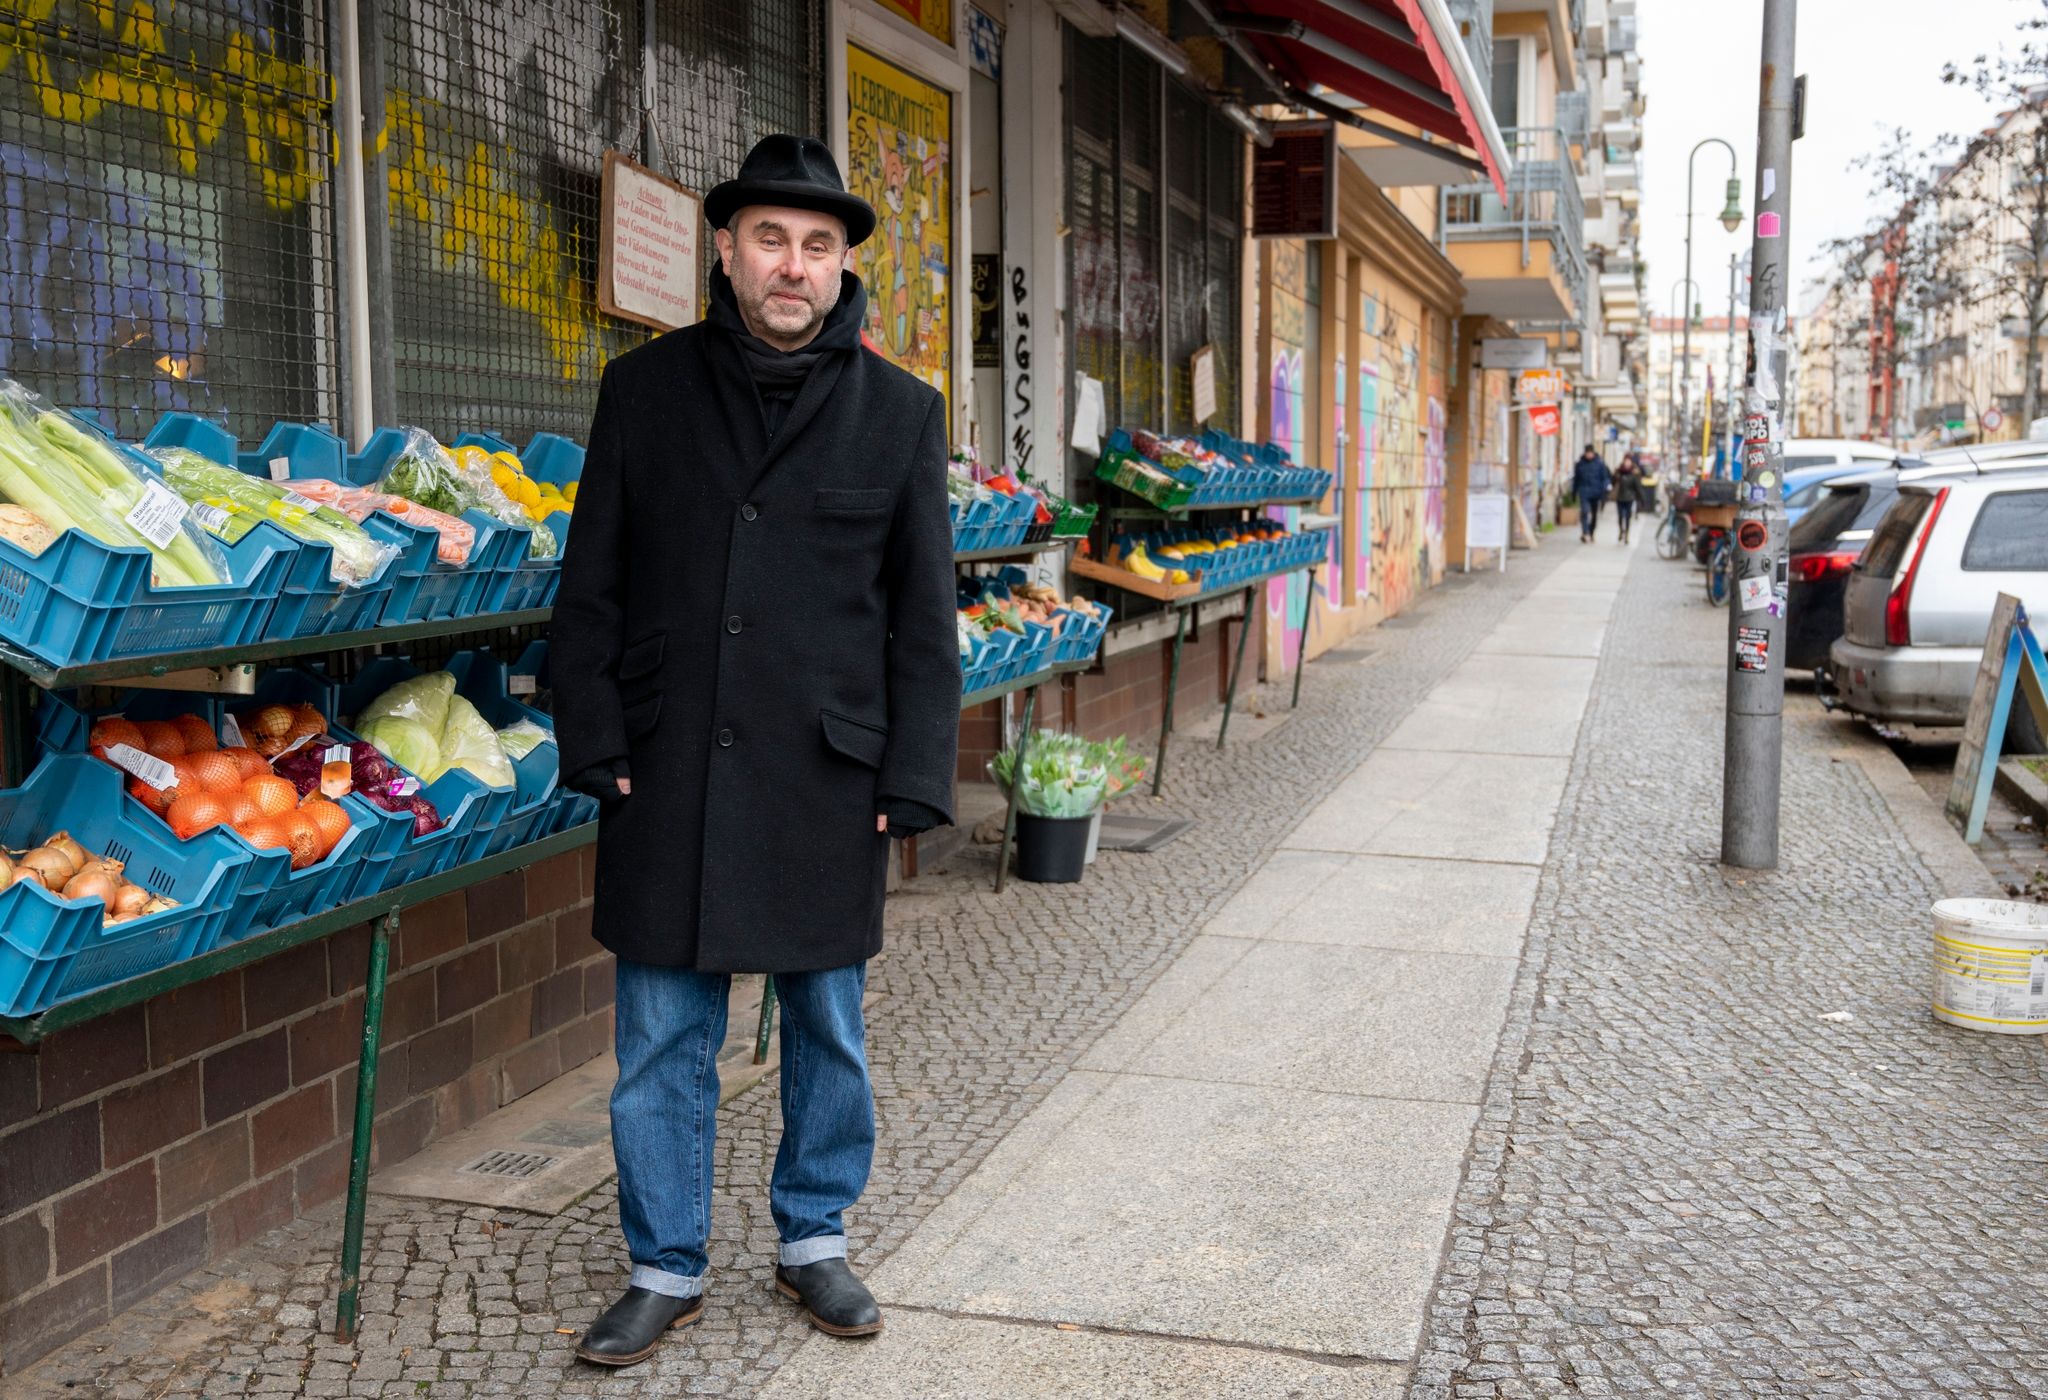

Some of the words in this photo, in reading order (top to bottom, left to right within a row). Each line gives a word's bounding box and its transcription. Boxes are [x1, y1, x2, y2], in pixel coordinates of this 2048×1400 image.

[853, 71, 937, 144] LEBENSMITTEL
[617, 193, 630, 209] Der
[631, 200, 650, 219] Laden
[651, 212, 663, 225] und
[663, 216, 673, 230] der
[638, 186, 663, 208] Achtung
[616, 215, 630, 229] und
[631, 220, 670, 247] Gemüsestand
[671, 240, 692, 257] werden
[616, 233, 627, 247] mit
[628, 237, 670, 265] Videokameras
[616, 251, 649, 275] überwacht.
[650, 265, 667, 281] Jeder
[616, 269, 645, 292] Diebstahl
[646, 283, 660, 298] wird
